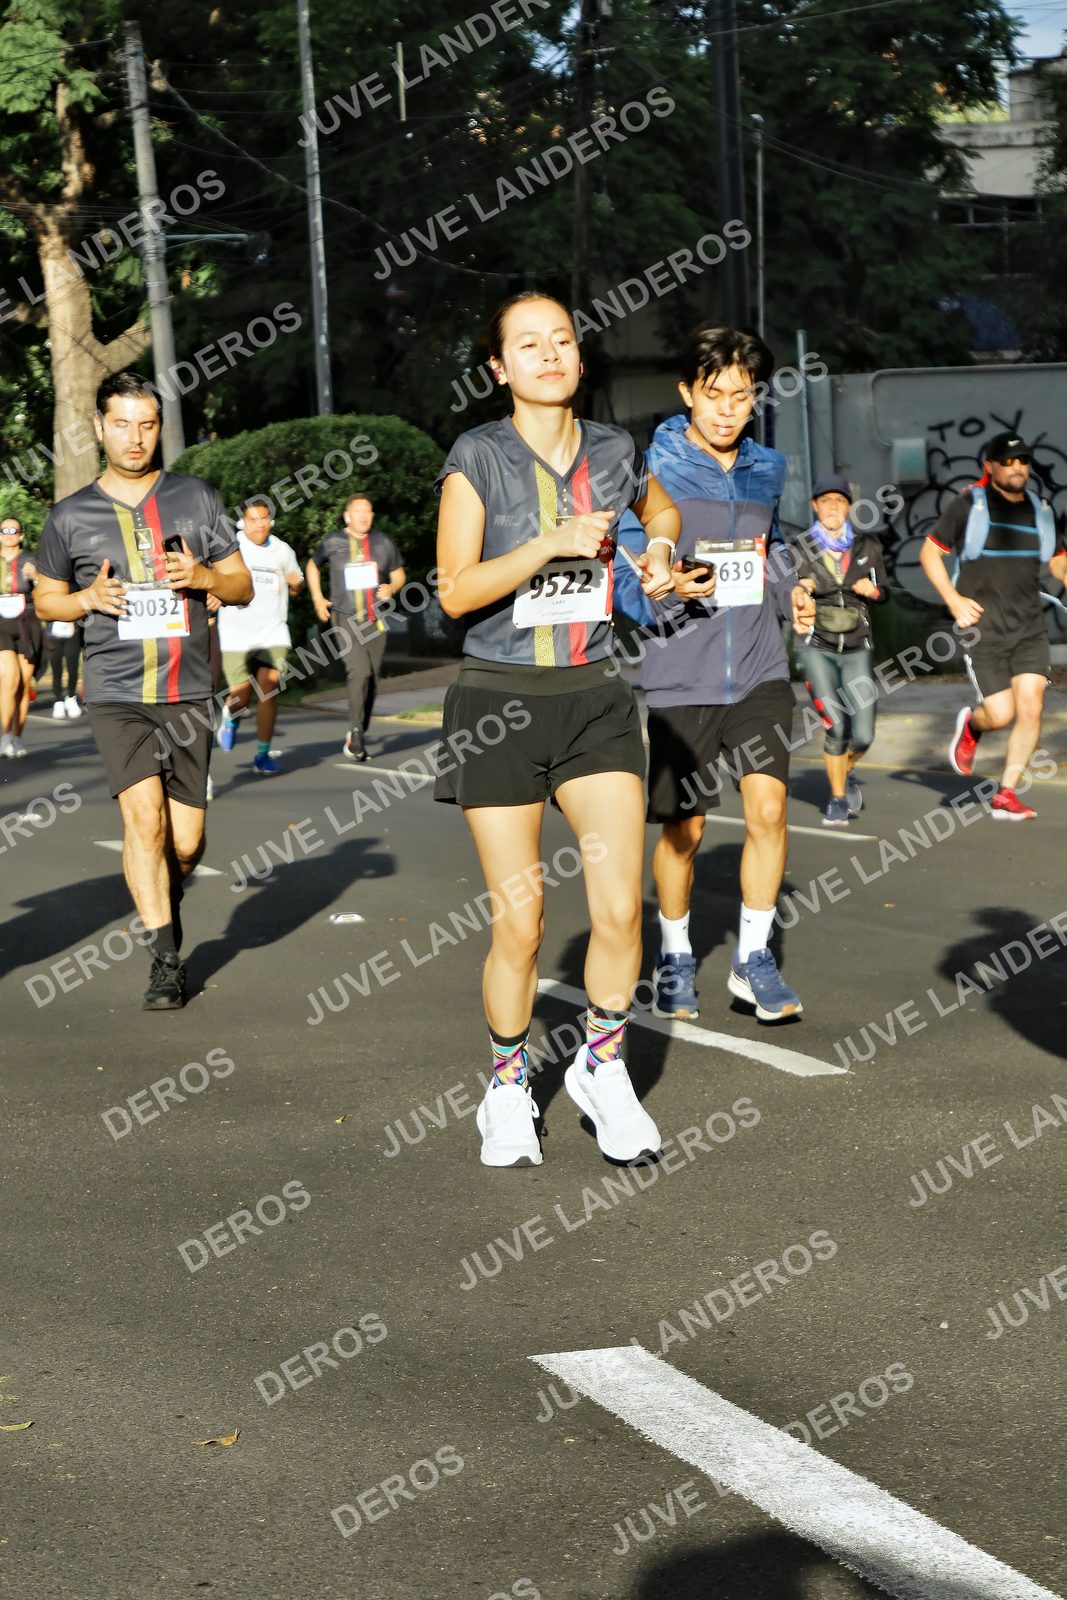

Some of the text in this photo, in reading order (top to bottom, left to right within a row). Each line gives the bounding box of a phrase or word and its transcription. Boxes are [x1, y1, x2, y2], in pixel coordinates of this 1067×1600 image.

[714, 561, 753, 582] 639
[529, 569, 593, 600] 9522
[128, 597, 180, 617] 0032
